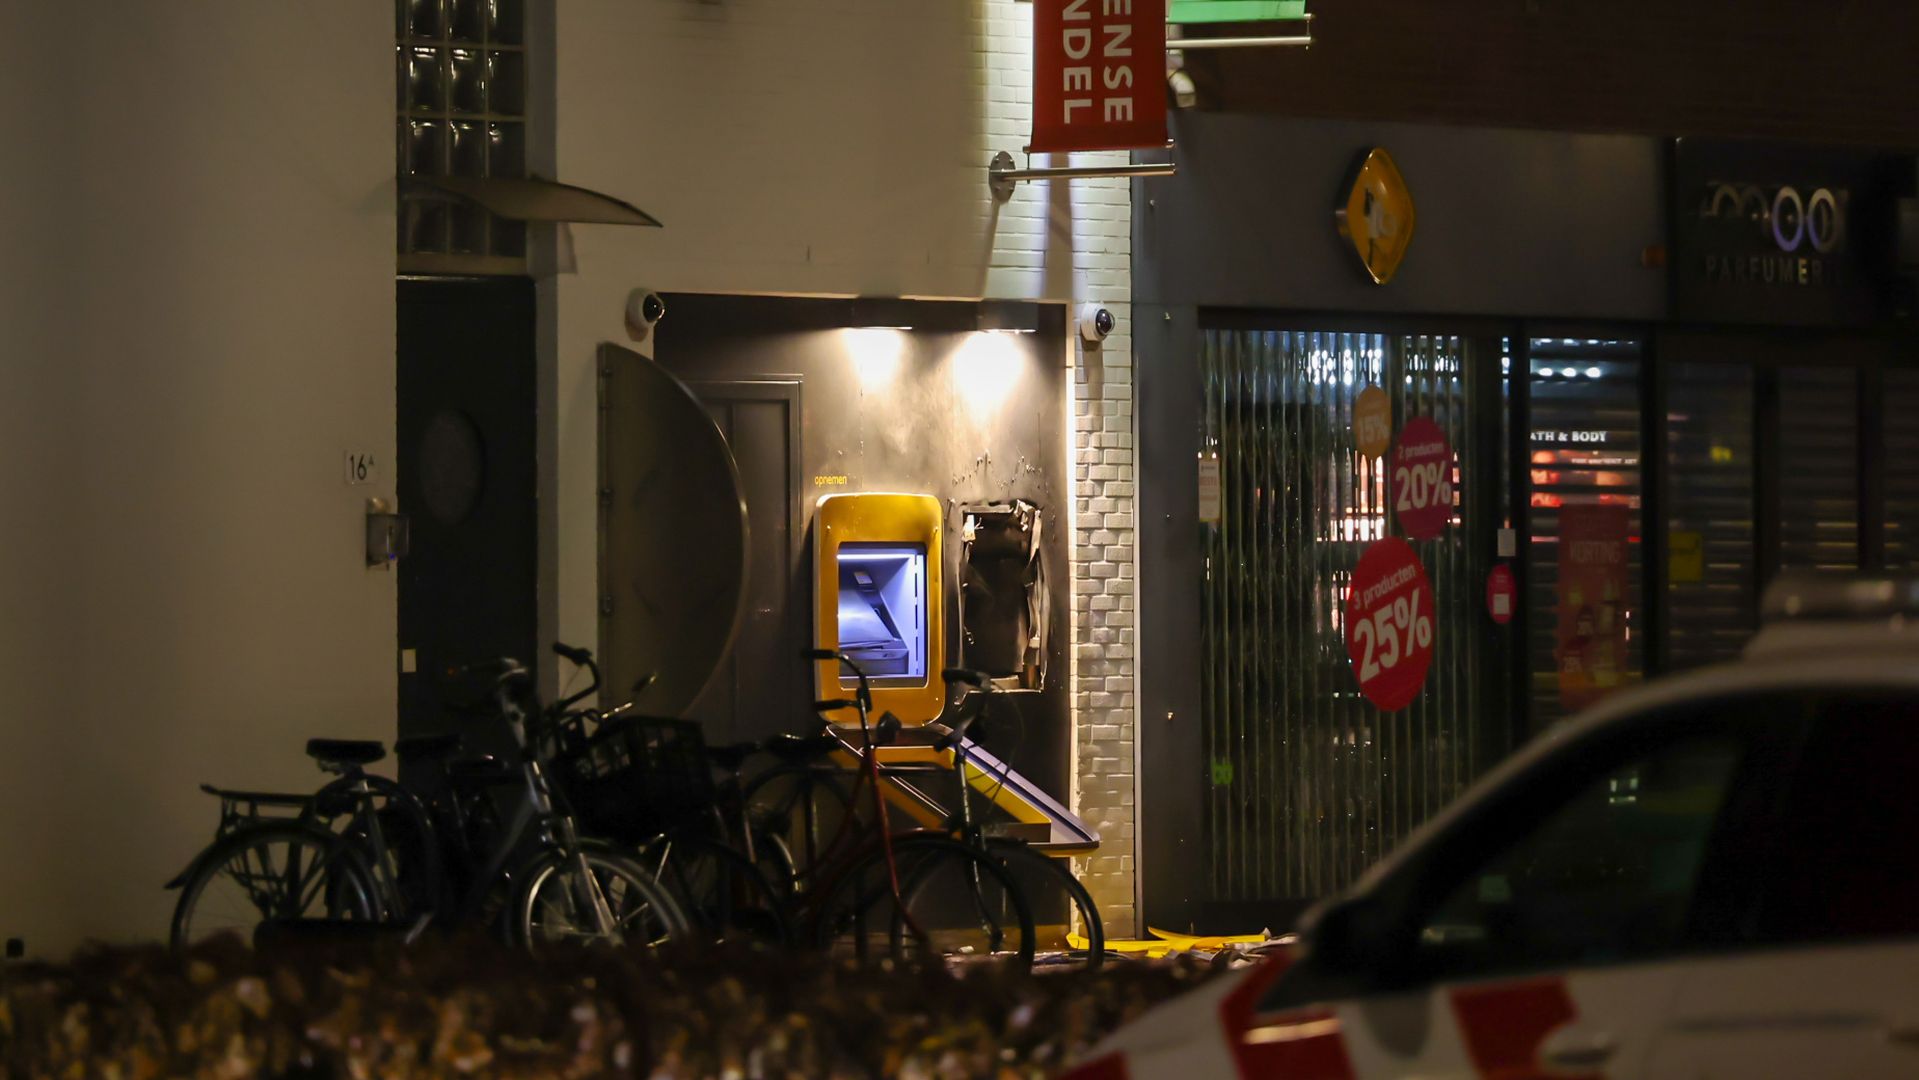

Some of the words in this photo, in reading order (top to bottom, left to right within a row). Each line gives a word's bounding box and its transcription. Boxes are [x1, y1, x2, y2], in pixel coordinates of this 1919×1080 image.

[1062, 0, 1092, 124] NDEL
[1103, 0, 1133, 122] ENSE
[1558, 432, 1568, 441] &
[1571, 431, 1607, 442] BODY
[815, 475, 847, 487] opnemen
[1395, 460, 1451, 511] 20%
[1353, 590, 1361, 610] 3
[1364, 564, 1416, 609] producten
[1354, 587, 1431, 683] 25%
